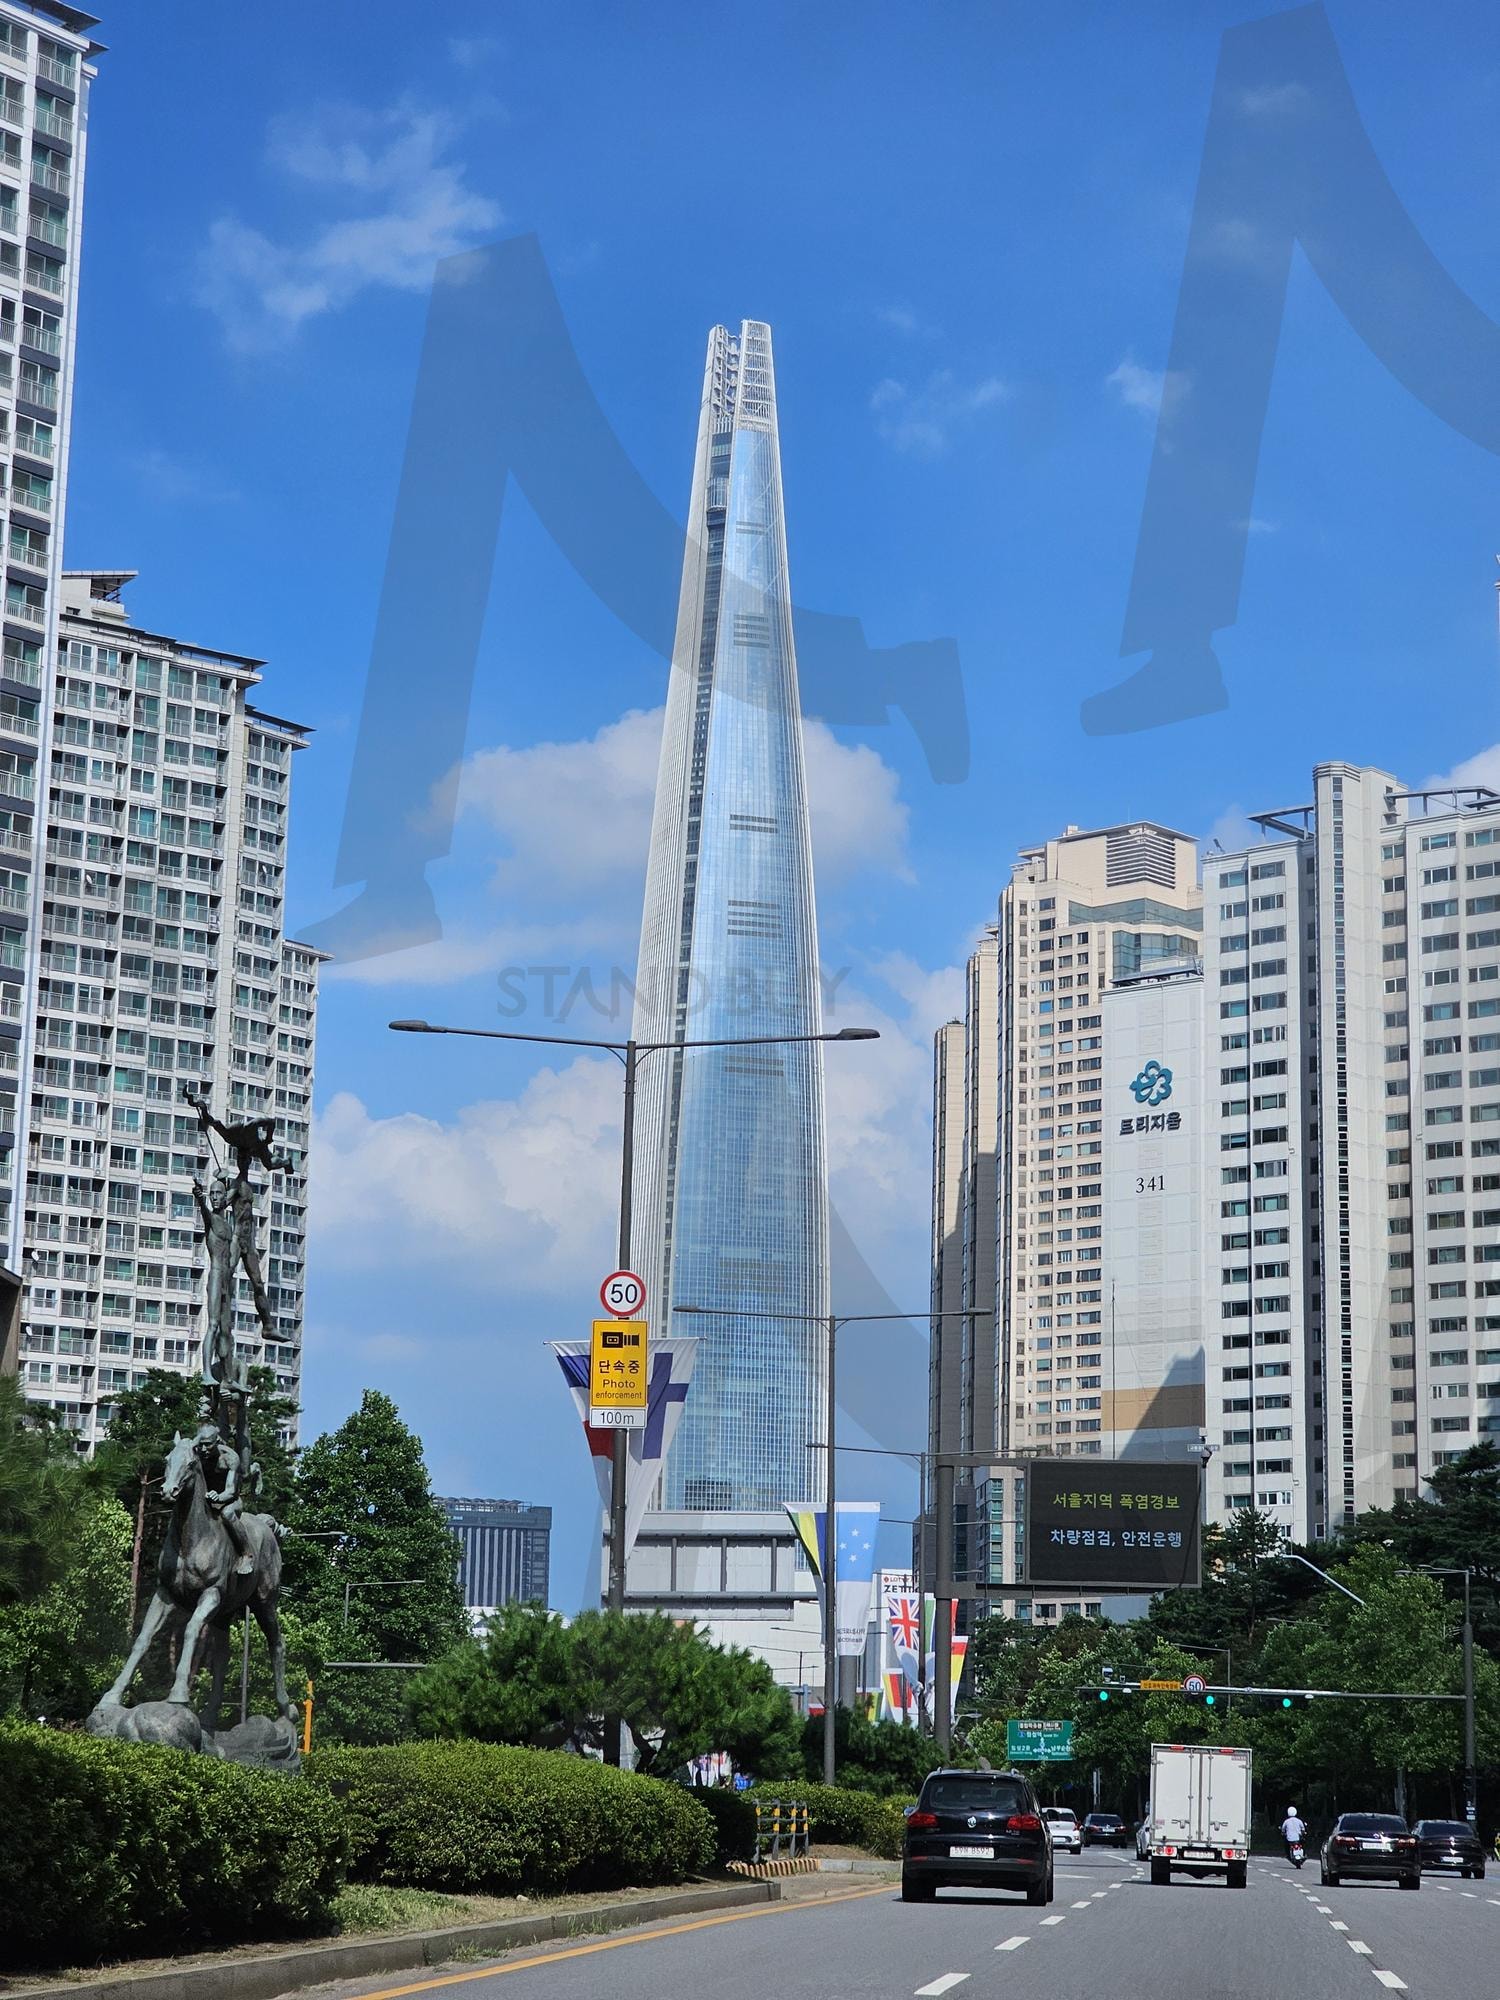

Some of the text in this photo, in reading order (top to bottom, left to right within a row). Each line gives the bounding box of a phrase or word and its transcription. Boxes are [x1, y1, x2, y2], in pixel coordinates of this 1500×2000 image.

[1119, 1111, 1182, 1136] 트리지움
[1135, 1175, 1166, 1194] 341
[610, 1283, 638, 1304] 50
[598, 1360, 641, 1374] 단속중
[602, 1379, 636, 1389] Photo
[595, 1390, 643, 1400] enforcement
[599, 1411, 635, 1425] 100m
[1052, 1493, 1181, 1510] 서울지역 폭염경보
[1050, 1529, 1182, 1548] 차량점검, 안전운행
[1188, 1681, 1202, 1691] 50
